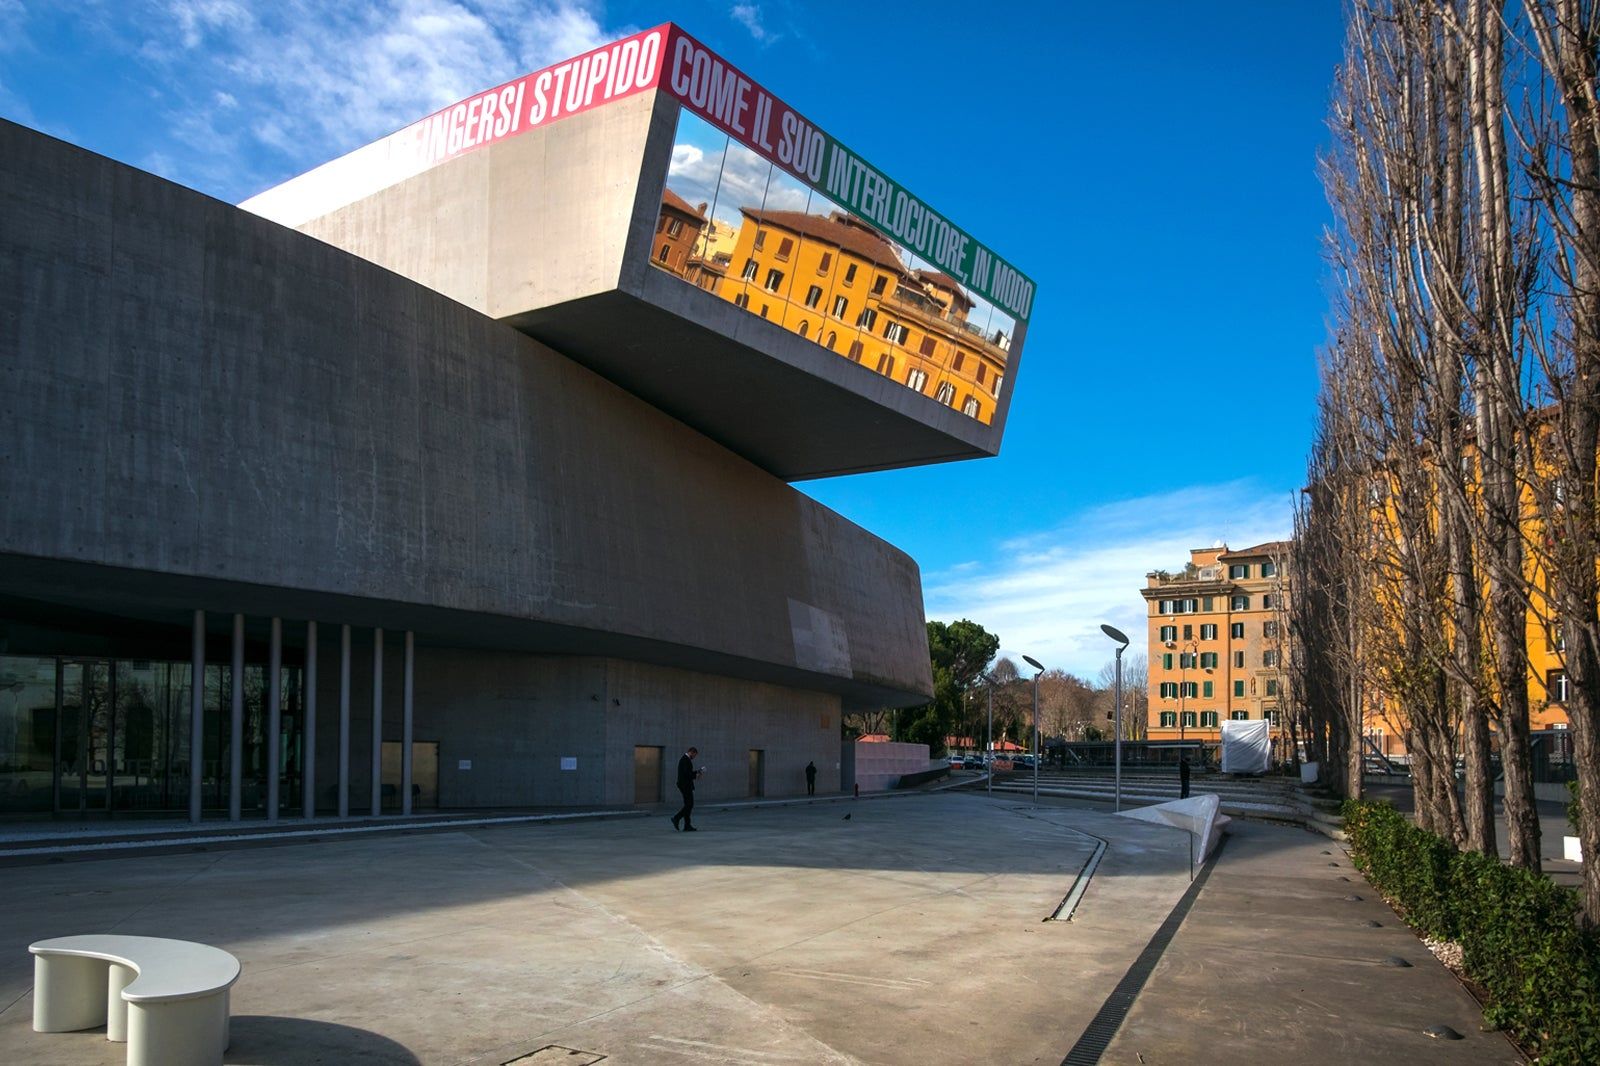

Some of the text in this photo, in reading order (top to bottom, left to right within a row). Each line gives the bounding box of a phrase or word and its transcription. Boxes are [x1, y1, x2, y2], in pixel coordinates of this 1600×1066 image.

[529, 31, 662, 126] STUPIDO
[671, 36, 1034, 320] COME IL SUO INTERLOCUTORE, IN MODO
